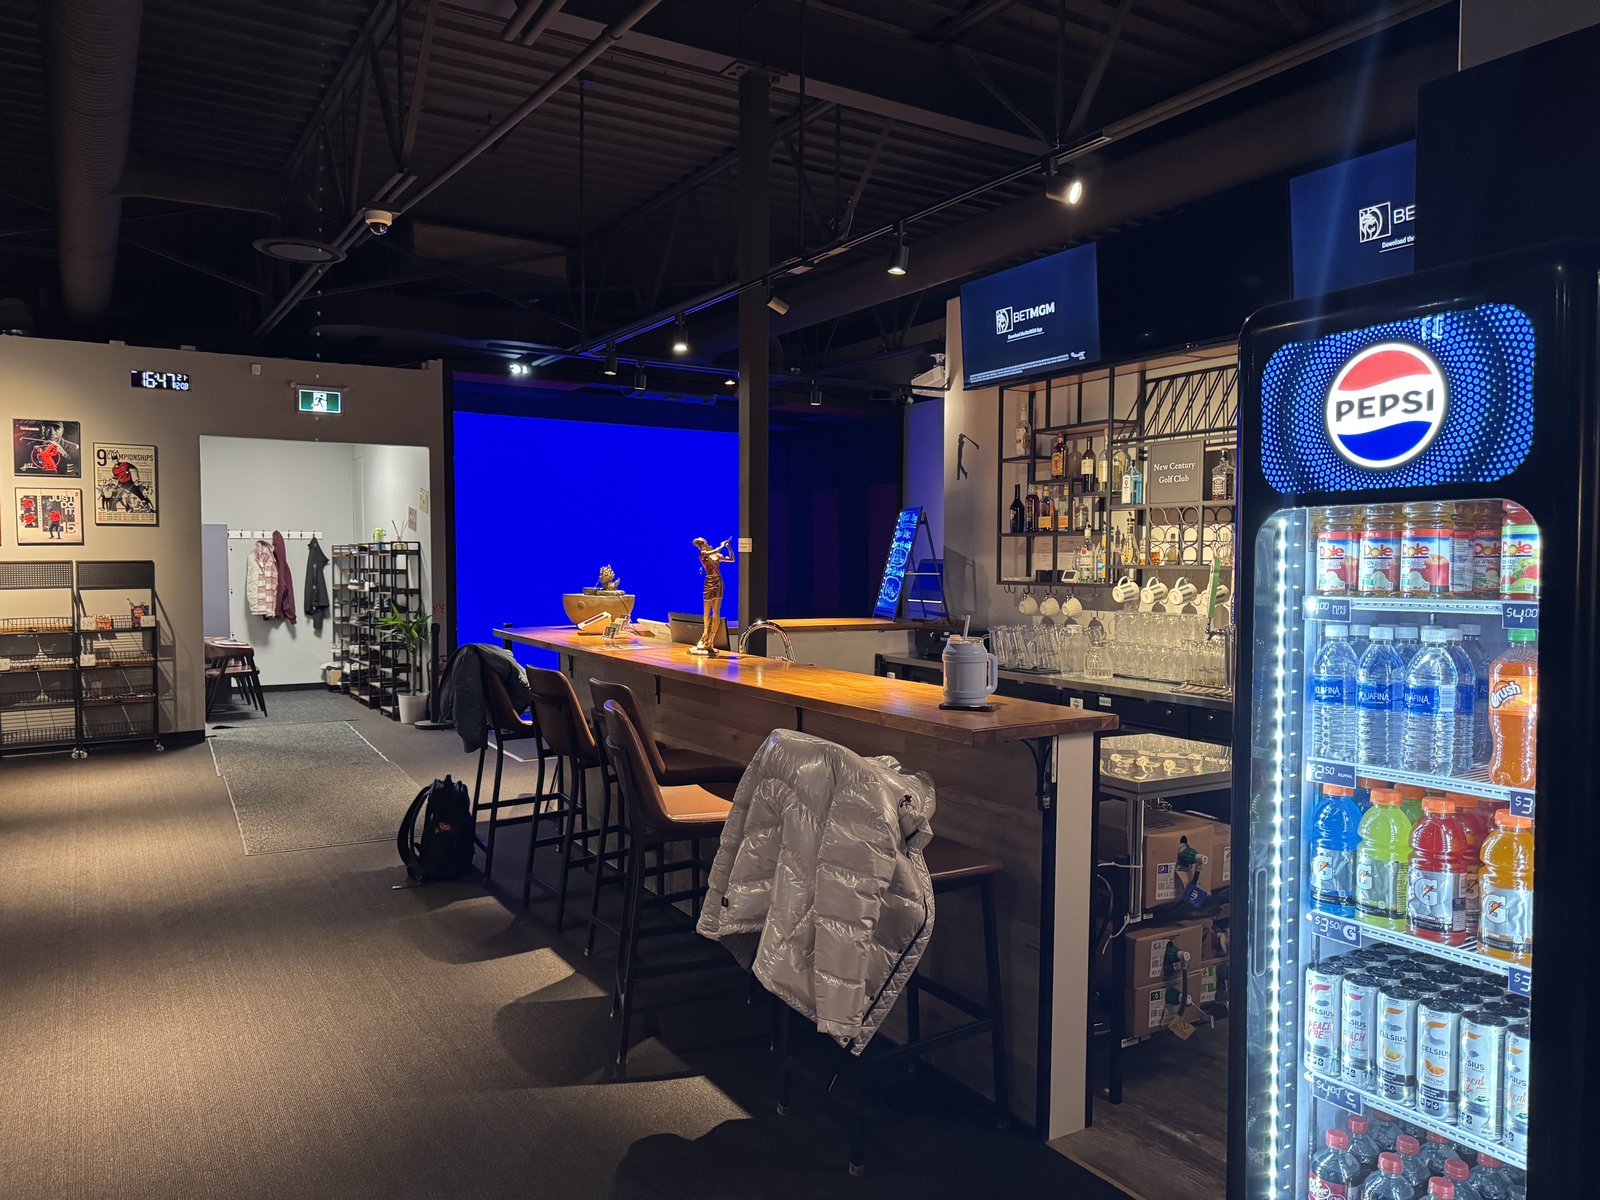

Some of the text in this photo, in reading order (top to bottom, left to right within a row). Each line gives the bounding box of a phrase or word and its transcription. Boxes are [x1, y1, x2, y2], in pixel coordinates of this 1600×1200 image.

[1013, 301, 1055, 323] BETMGM
[1335, 388, 1434, 423] PEPSI
[96, 449, 107, 467] 9
[107, 453, 154, 462] CMPIONSHIPS
[1153, 461, 1196, 471] New Century
[1158, 473, 1190, 484] Golf Club
[1363, 543, 1394, 558] Dole
[1503, 540, 1533, 556] Dole
[1490, 680, 1522, 709] Crush
